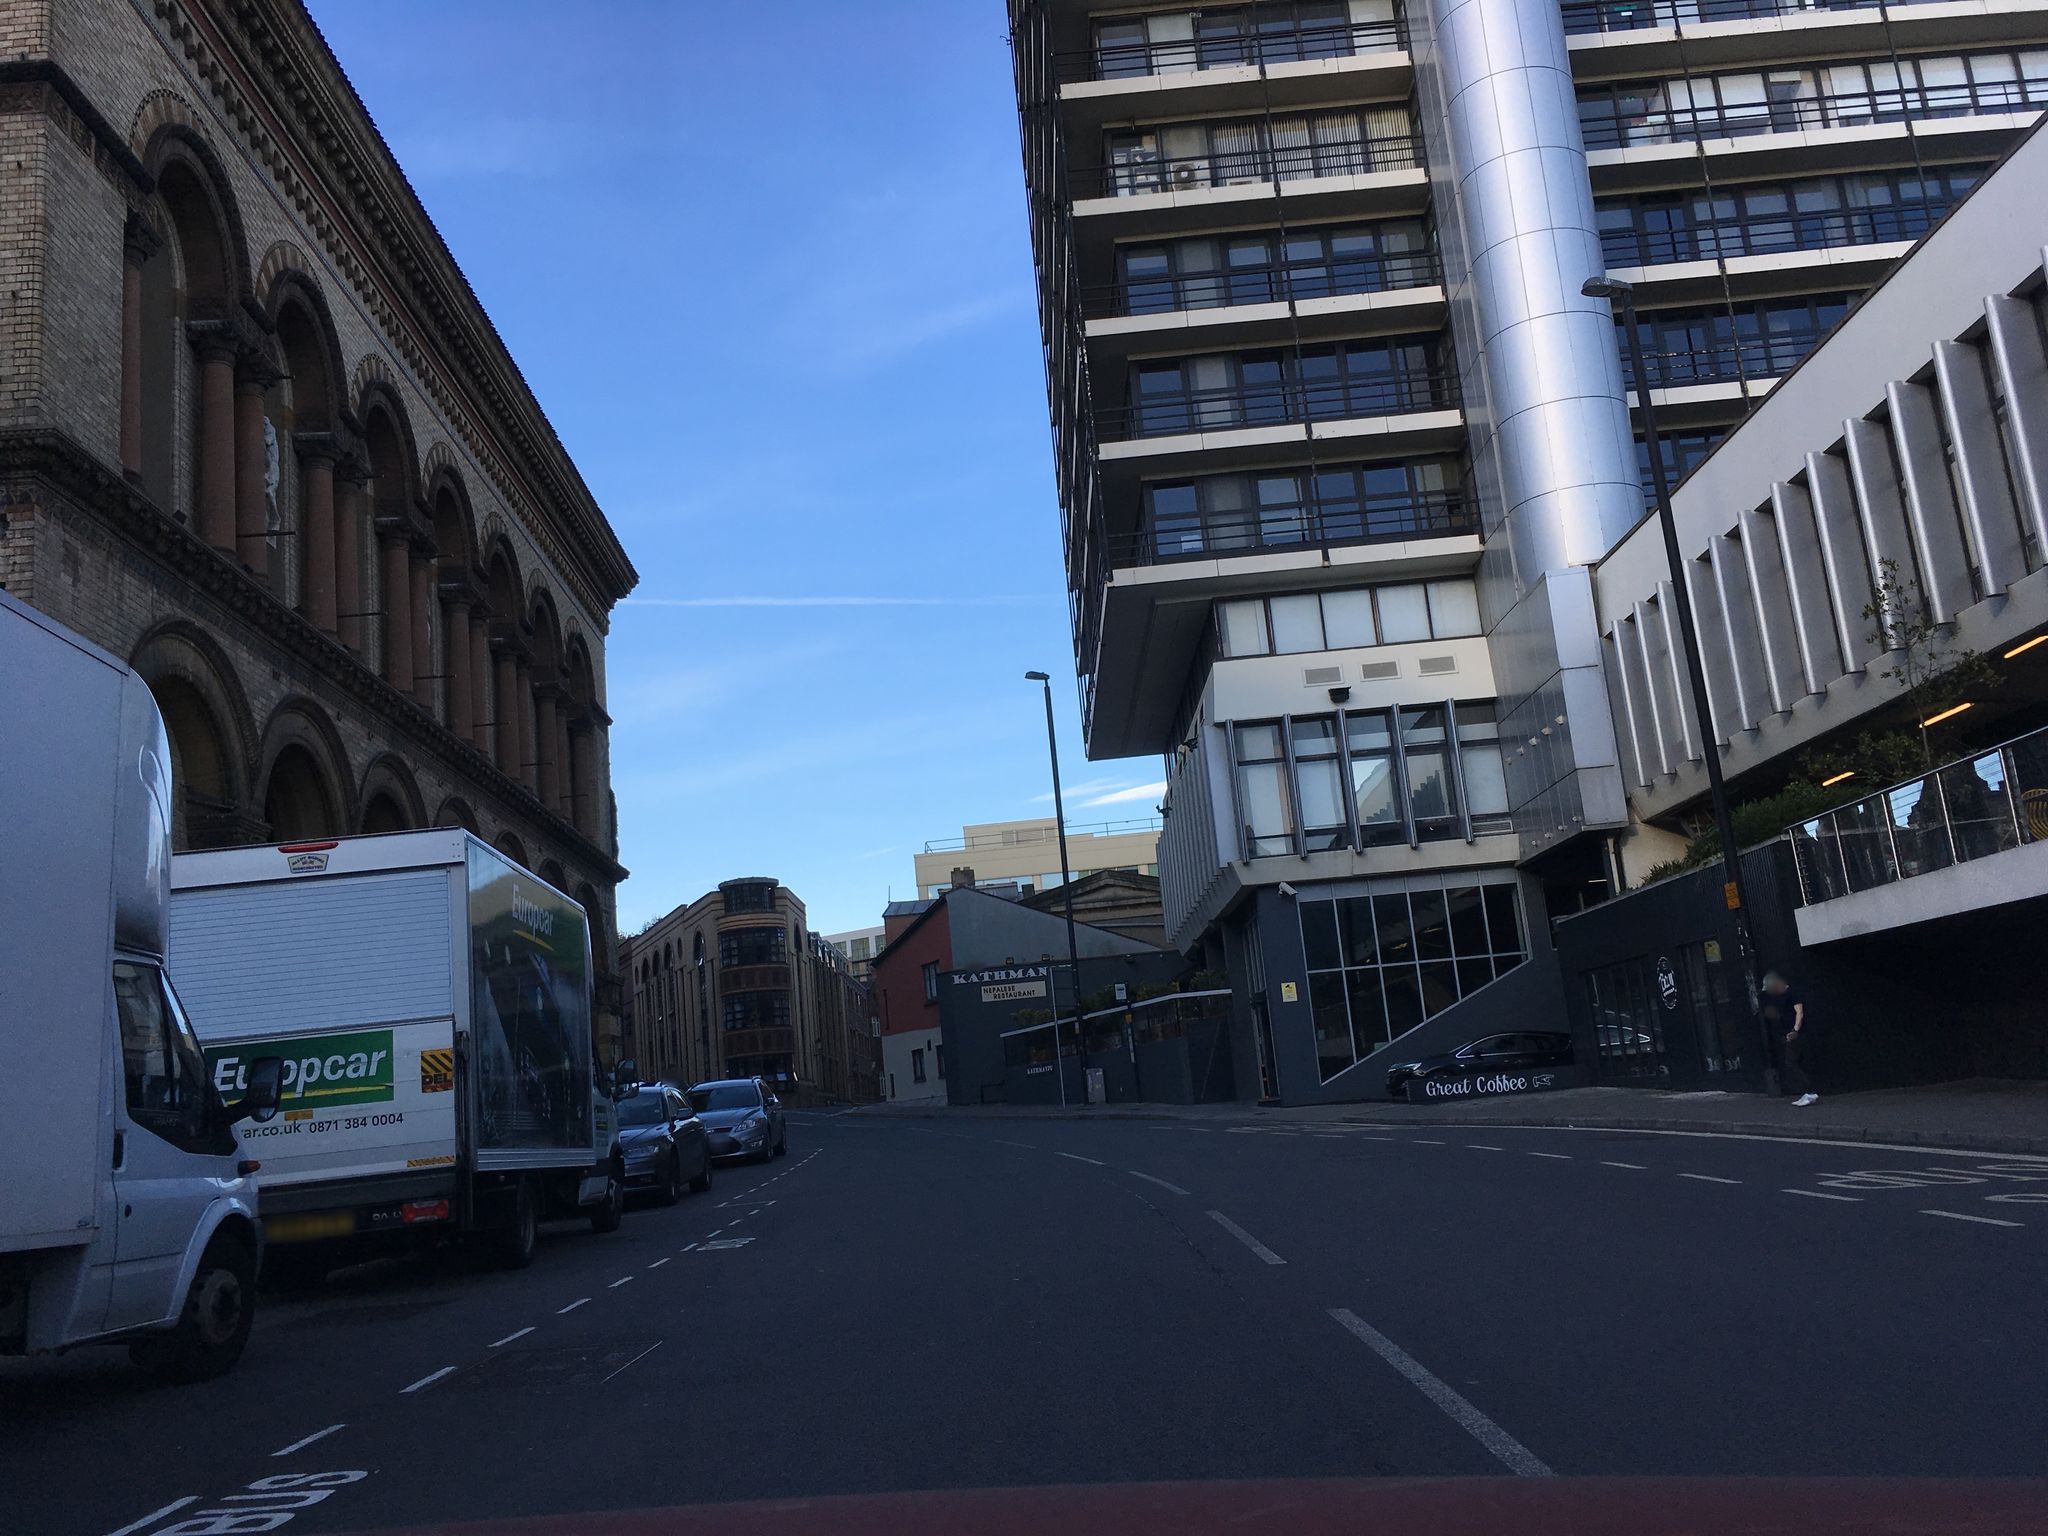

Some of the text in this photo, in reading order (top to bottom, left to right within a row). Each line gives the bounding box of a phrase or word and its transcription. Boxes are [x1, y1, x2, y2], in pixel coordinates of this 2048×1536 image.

[512, 883, 554, 942] Europcar
[983, 985, 1015, 994] NEPALESE
[993, 990, 1035, 1000] RESTAURANT
[213, 1049, 387, 1099] Euopcar
[1425, 1074, 1528, 1097] Great Coffee
[241, 1113, 404, 1139] ar.co.uk 0871 384 0004
[147, 1470, 369, 1536] BUS
